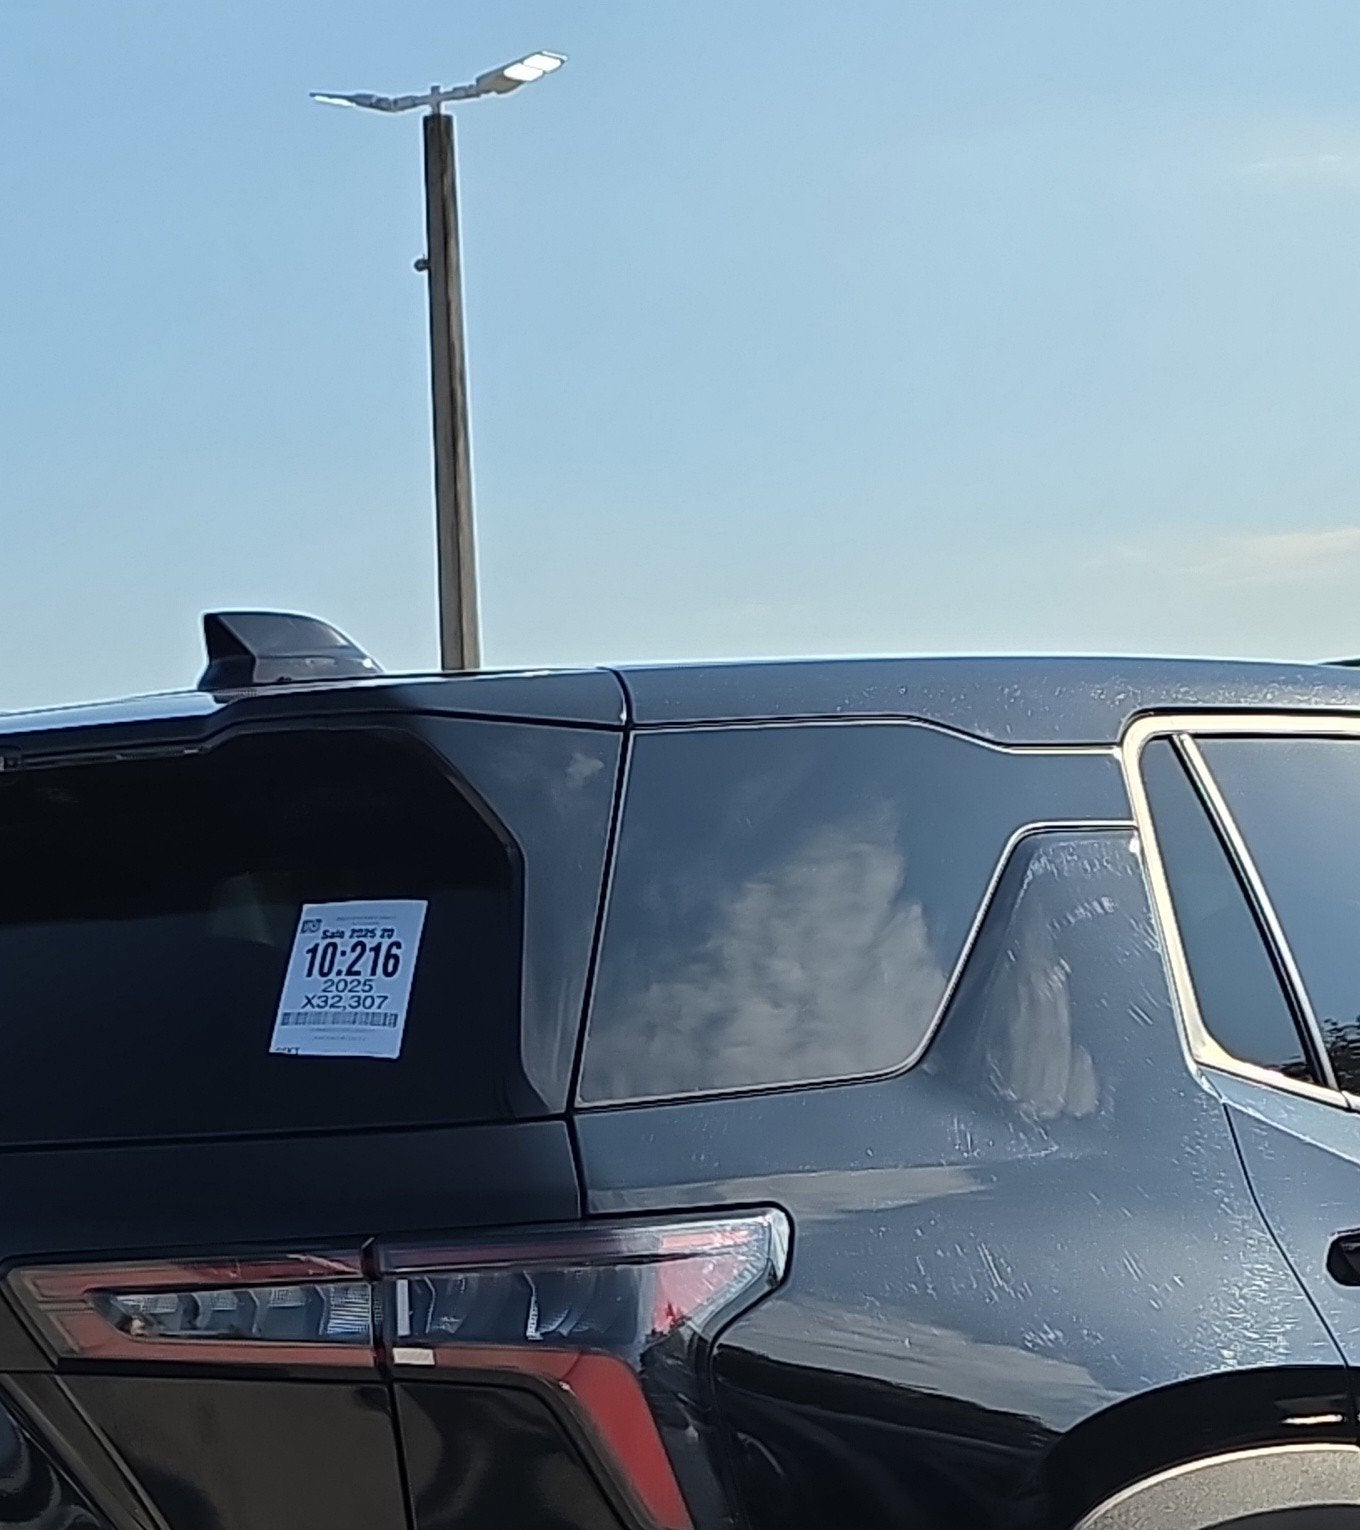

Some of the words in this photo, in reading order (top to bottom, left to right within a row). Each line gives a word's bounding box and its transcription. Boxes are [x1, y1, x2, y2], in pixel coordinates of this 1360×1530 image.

[305, 940, 403, 978] 10:216
[321, 978, 374, 993] 2025
[301, 995, 389, 1011] X32,307
